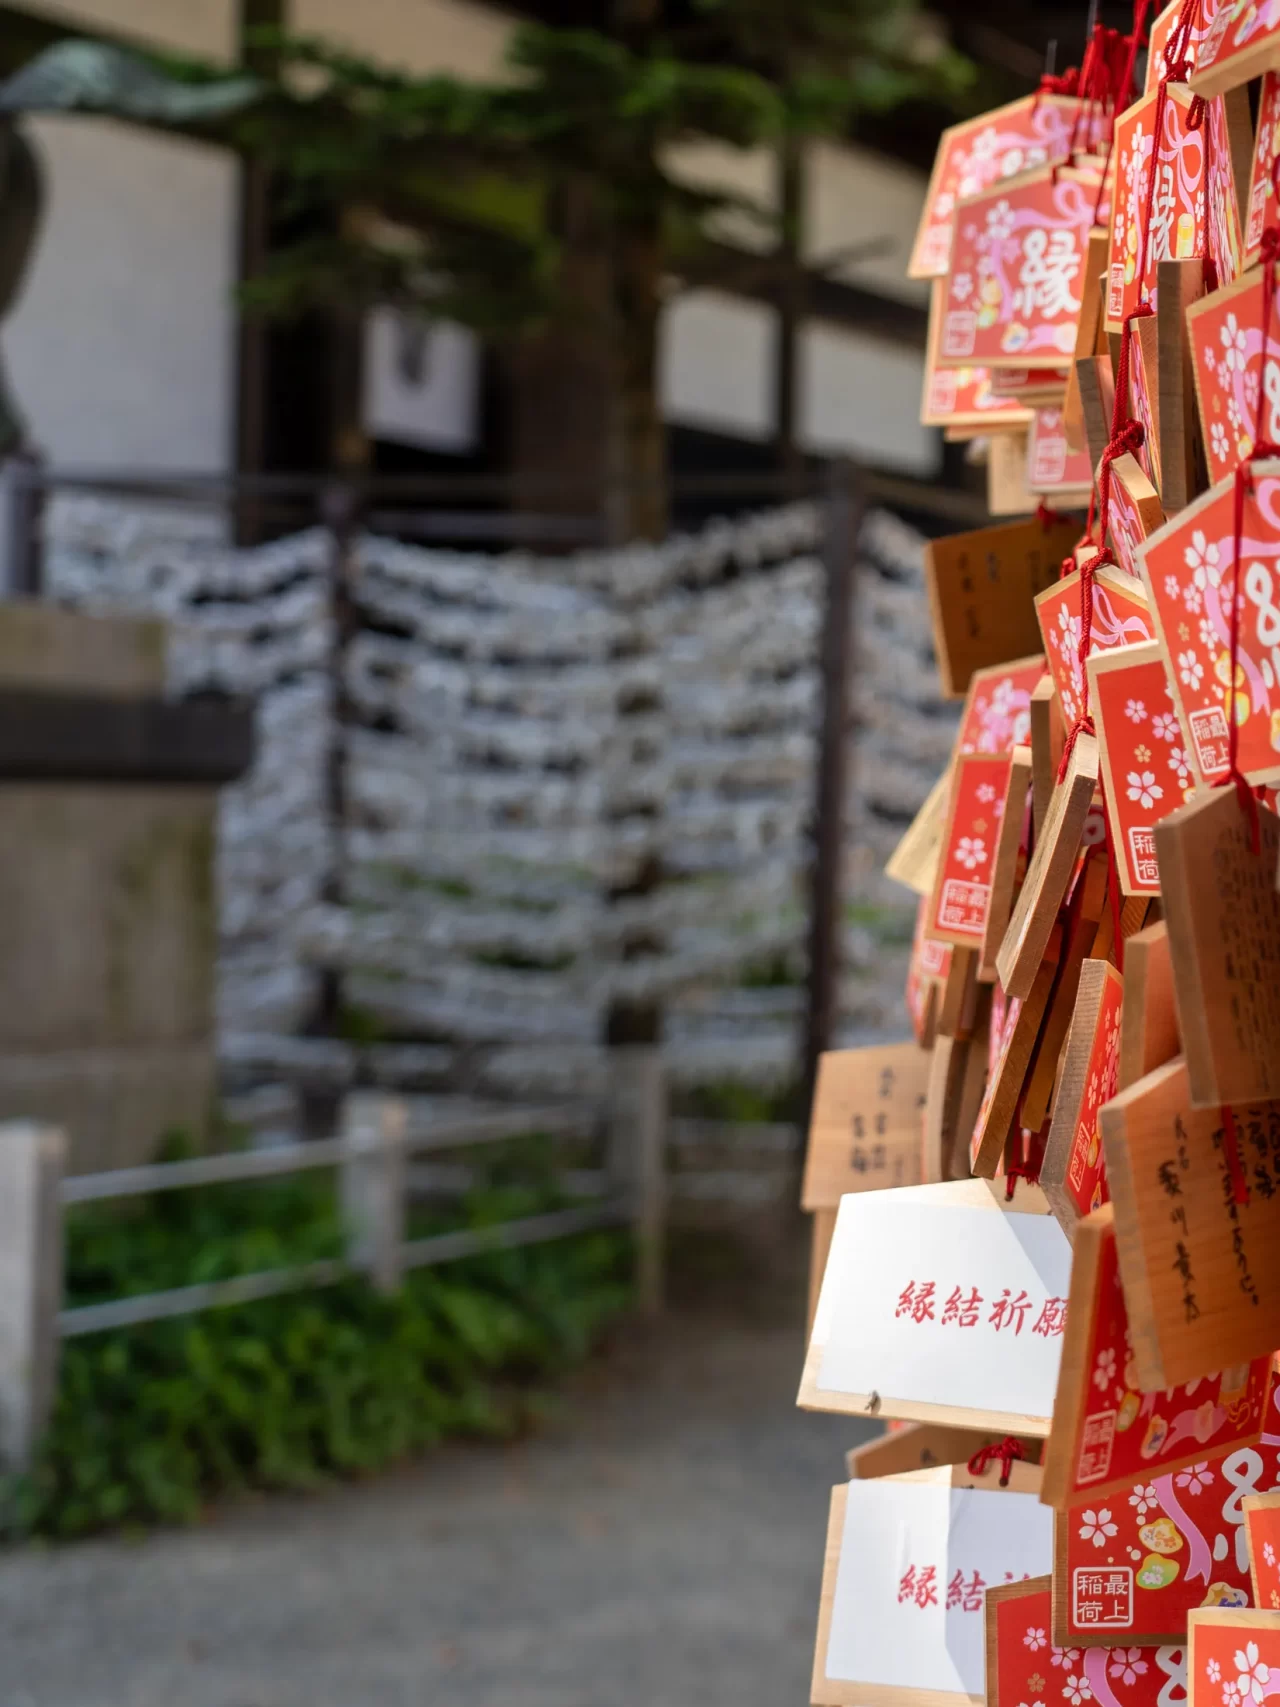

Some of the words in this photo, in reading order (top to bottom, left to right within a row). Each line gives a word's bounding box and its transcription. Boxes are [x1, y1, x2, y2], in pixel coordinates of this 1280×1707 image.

[895, 1280, 1068, 1338] 縁結祈願
[897, 1564, 1031, 1613] 縁結
